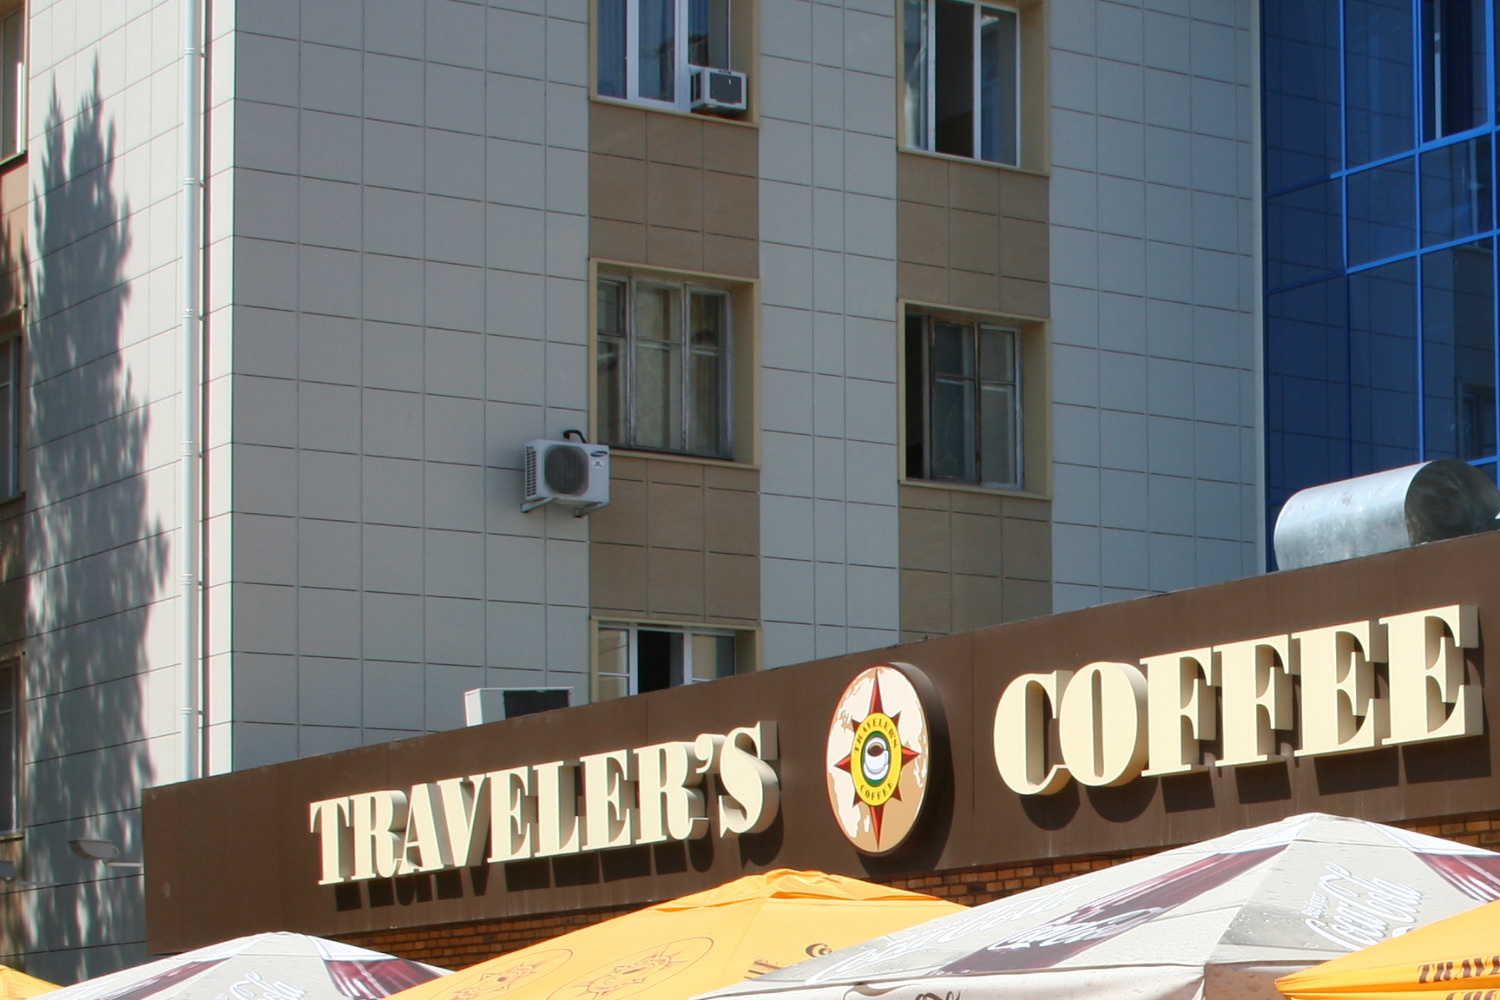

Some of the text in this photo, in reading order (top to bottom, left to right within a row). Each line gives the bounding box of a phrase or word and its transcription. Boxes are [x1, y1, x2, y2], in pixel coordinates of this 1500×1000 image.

[309, 604, 1482, 886] TRAVELER'S COFFEE
[854, 717, 897, 752] TRAVELER'S
[860, 782, 893, 800] COFFEE
